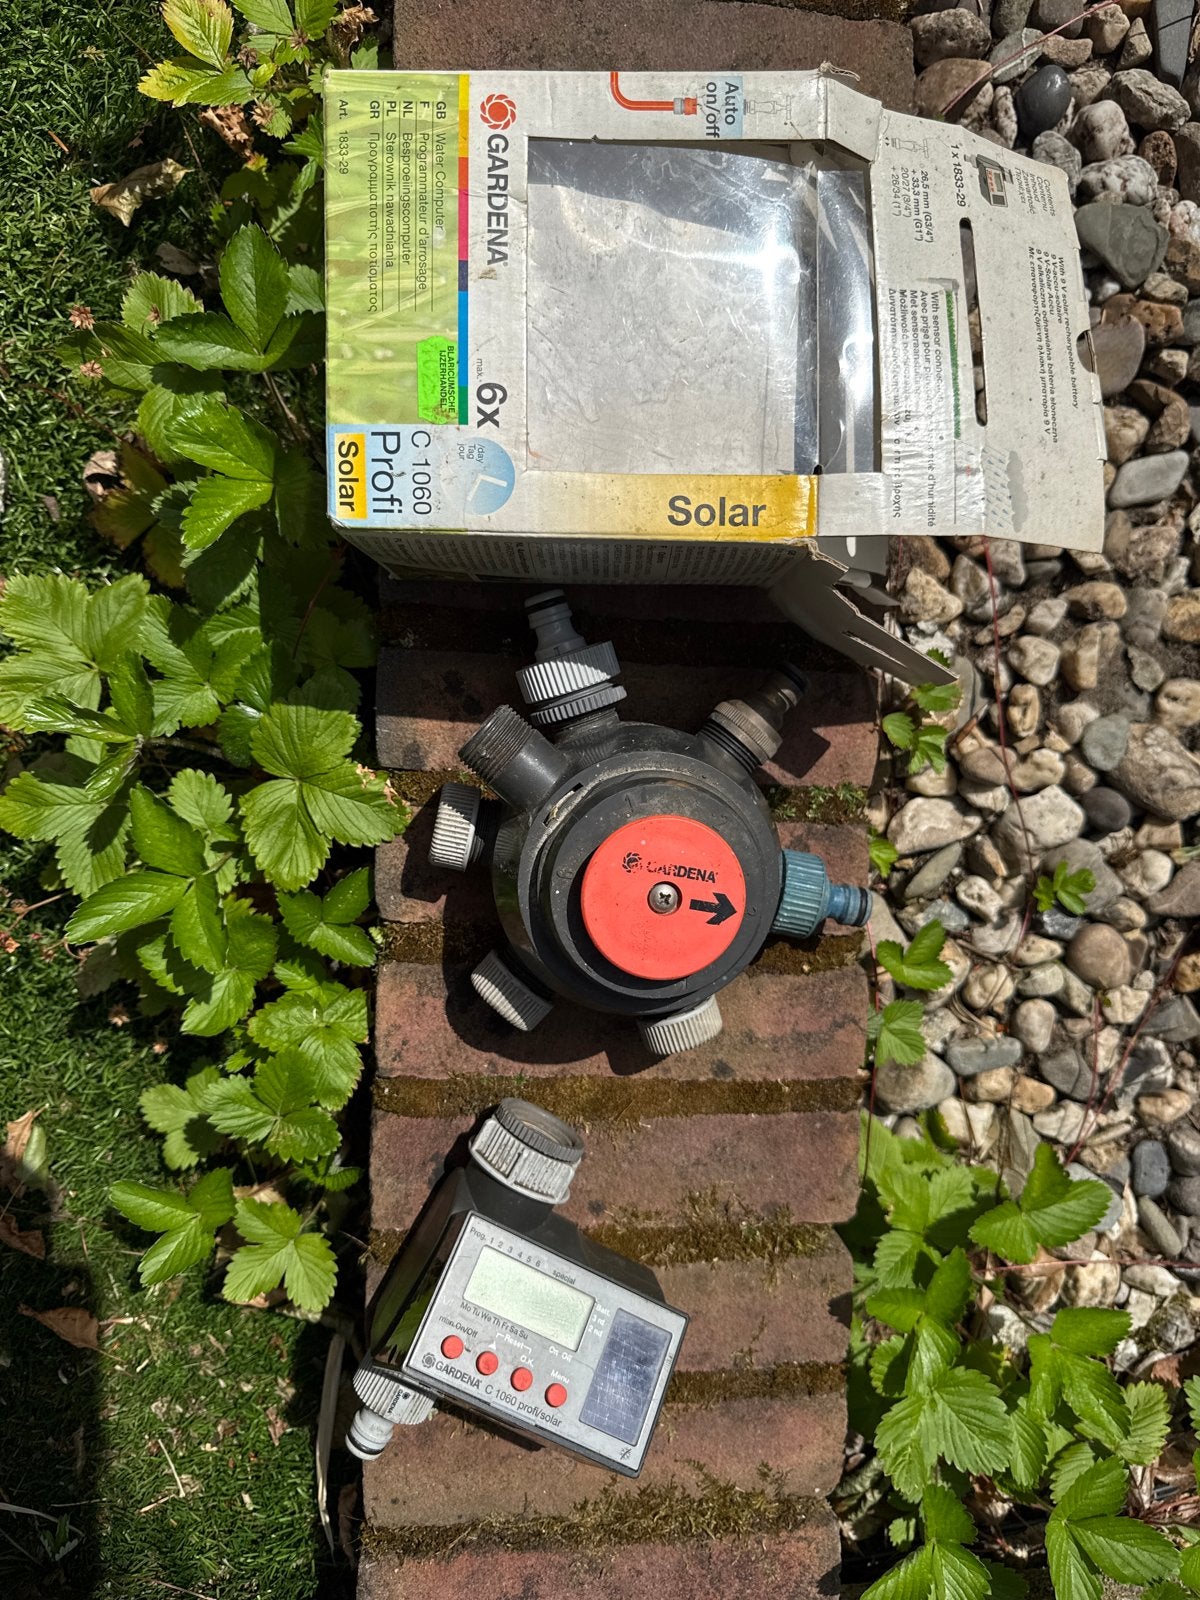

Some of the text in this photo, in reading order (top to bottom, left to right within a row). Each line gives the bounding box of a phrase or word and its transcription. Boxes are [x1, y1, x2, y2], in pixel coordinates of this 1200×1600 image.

[370, 100, 380, 119] GR
[706, 82, 720, 138] on/off
[725, 81, 739, 125] Auto
[339, 100, 349, 174] Art. 1833-29
[952, 151, 959, 159] x
[400, 101, 413, 265] NL Besproeiingscomputer
[417, 132, 430, 224] Programmateur
[434, 101, 446, 230] GB Water Computer
[901, 167, 910, 192] 20/27
[920, 170, 930, 189] 26,5
[385, 101, 396, 268] PL Sterownik nawadniania
[487, 134, 509, 266] GARDENA
[892, 174, 901, 199] 26/34
[911, 177, 920, 196] 33,3
[923, 191, 930, 209] mm
[953, 162, 966, 207] 1833-29
[1030, 173, 1040, 203] Inhoud
[1036, 176, 1048, 212] Contenu
[1043, 179, 1056, 217] Contents
[914, 198, 920, 216] mm
[416, 228, 430, 290] d'arrosage
[1058, 257, 1066, 276] With
[920, 290, 930, 313] Avec
[1061, 285, 1067, 293] V
[910, 290, 921, 395] Met sensoraans
[921, 316, 931, 339] prise
[1038, 264, 1047, 309] alkaliczna
[1047, 363, 1056, 395] bateria
[922, 342, 932, 365] pour
[931, 292, 943, 403] With sensor connec
[1065, 317, 1077, 376] rechargeable
[439, 350, 447, 408] IJZERHANDEL
[448, 346, 456, 413] BLARICUMSCHE
[476, 358, 508, 429] max. 6x
[1070, 377, 1079, 409] battery
[1044, 427, 1051, 436] V
[457, 443, 466, 460] jour
[466, 444, 476, 459] Tag
[476, 443, 485, 463] /day
[338, 440, 359, 512] Solar
[371, 431, 403, 514] Profi
[411, 430, 432, 515] C 1060
[668, 495, 767, 527] Solar
[470, 1227, 486, 1242] Prog.
[498, 1240, 504, 1248] 2
[518, 1251, 523, 1259] 4
[526, 1255, 532, 1263] 5
[552, 1269, 576, 1285] special
[461, 1302, 528, 1340] Mo Tu We Th Fr Sa Su
[505, 1335, 524, 1350] Reset
[549, 1345, 573, 1363] On Off
[435, 1362, 562, 1428] GARDENA C 1060 profi/solar
[551, 1369, 570, 1384] Menu
